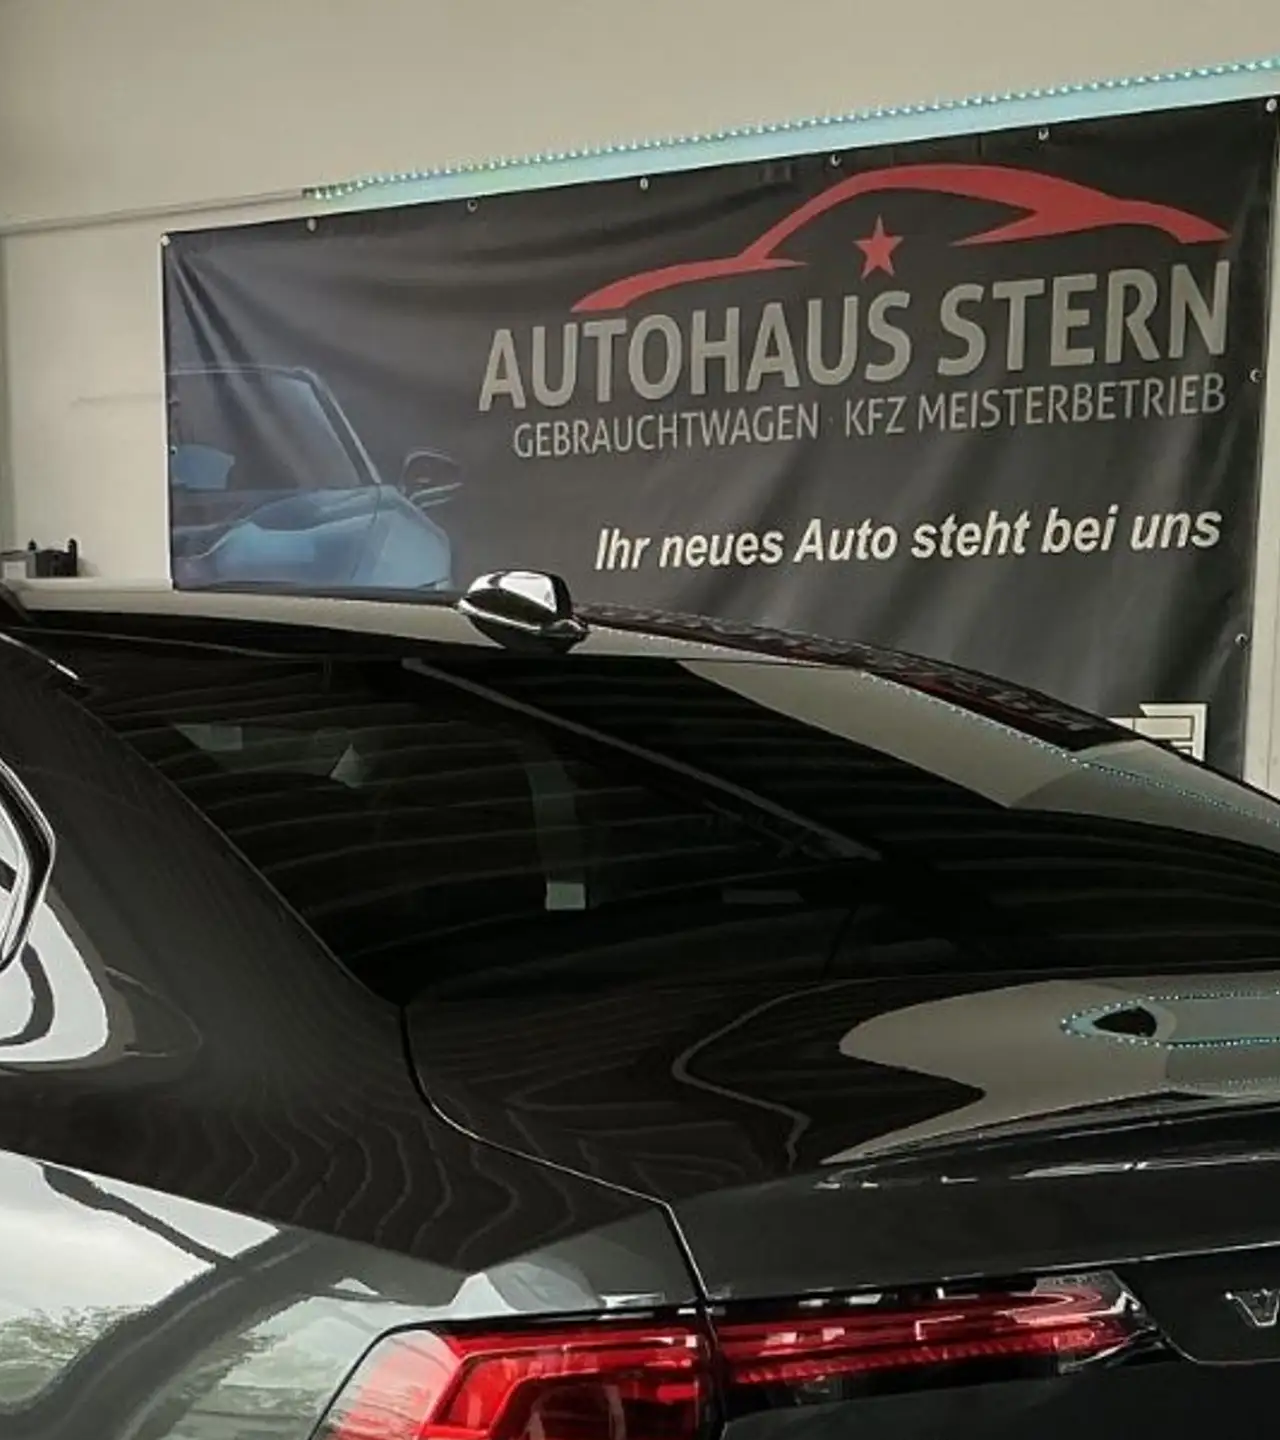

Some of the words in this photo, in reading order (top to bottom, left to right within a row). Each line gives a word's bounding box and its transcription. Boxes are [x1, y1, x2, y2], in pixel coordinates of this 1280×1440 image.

[478, 291, 911, 412] AUTOHAUS
[937, 260, 1231, 376] STERN
[514, 402, 820, 458] GEBRAUCHTWAGEN
[846, 396, 907, 438] KFZ
[919, 373, 1227, 431] MEISTERBETRIEB
[595, 527, 651, 571] Ihr
[659, 528, 784, 568] neues
[793, 519, 897, 563] Auto
[911, 509, 1030, 559] steht
[1041, 505, 1119, 553] bei
[1130, 509, 1222, 550] uns
